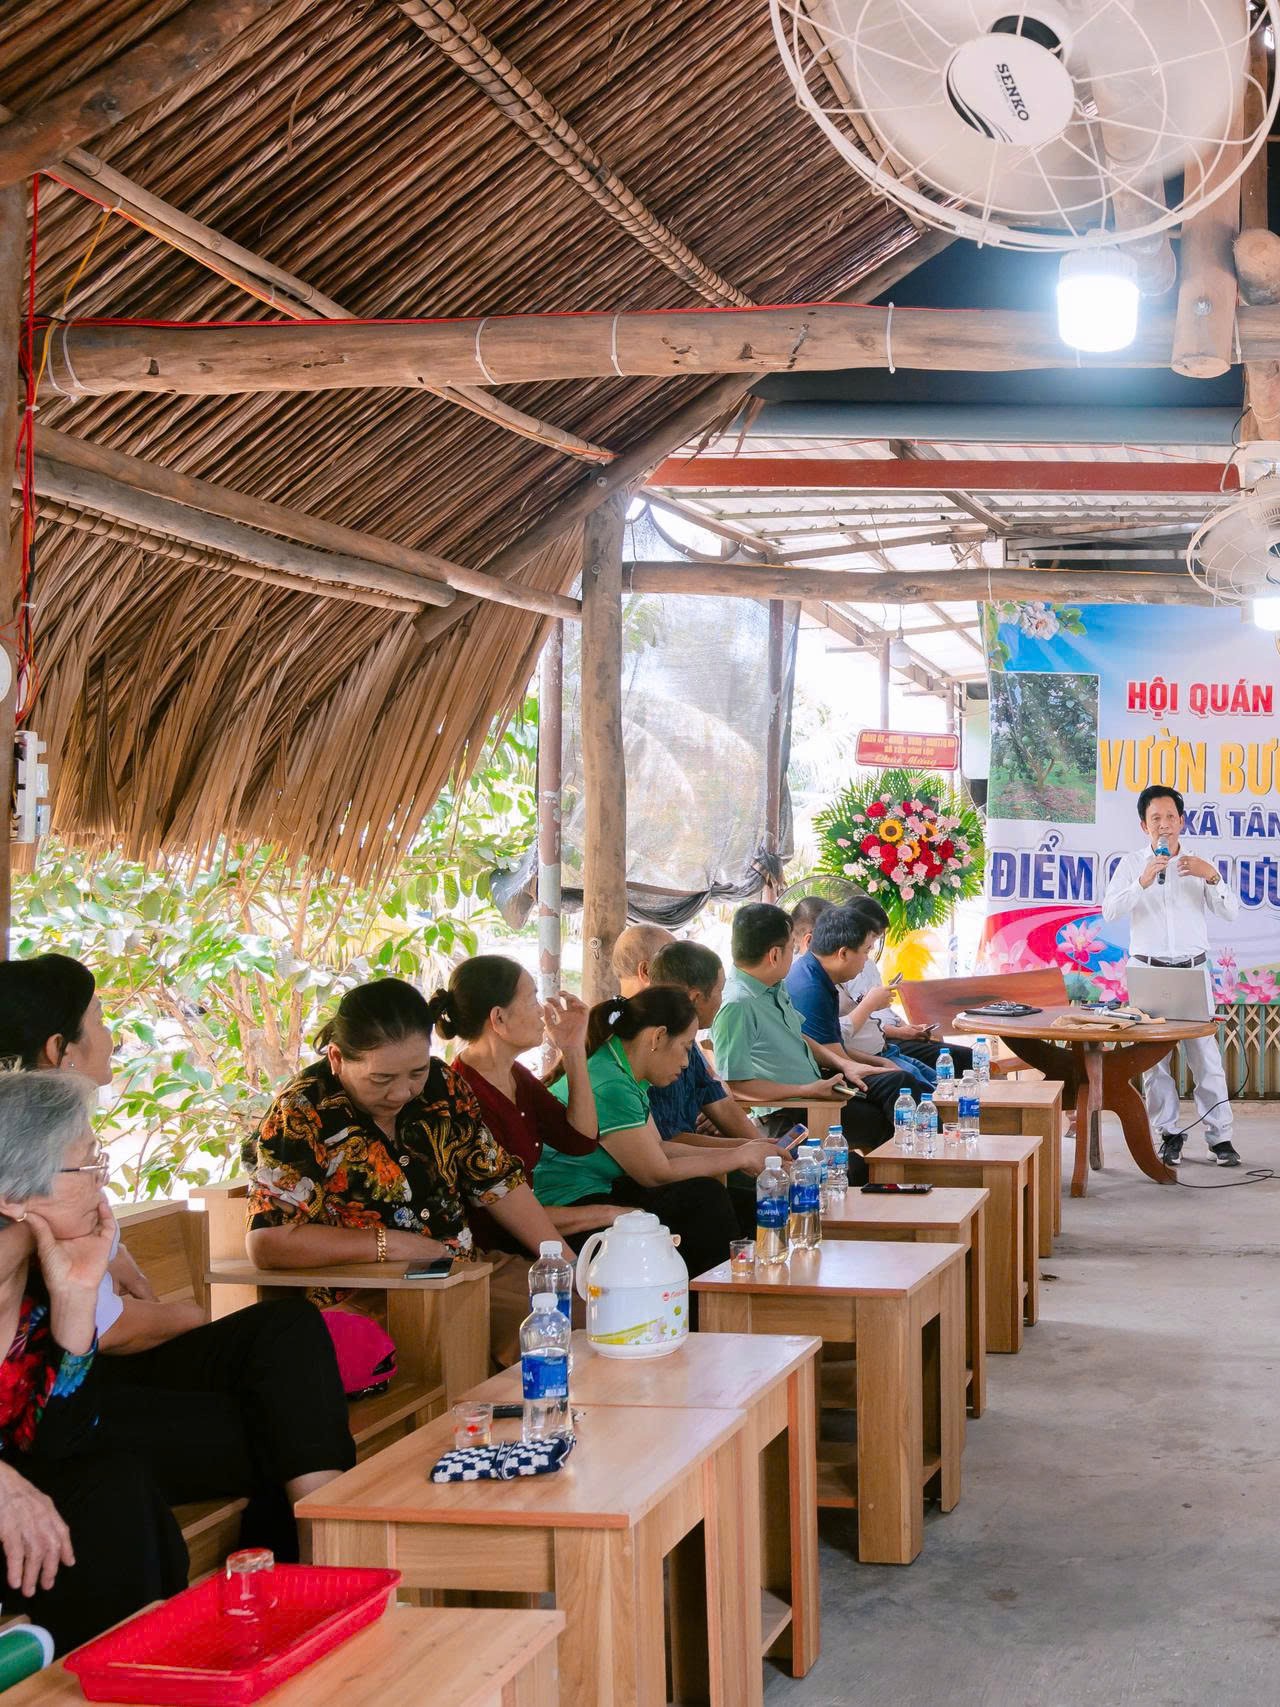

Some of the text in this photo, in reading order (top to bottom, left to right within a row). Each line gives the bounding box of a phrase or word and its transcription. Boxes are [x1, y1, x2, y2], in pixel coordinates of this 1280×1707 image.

[996, 63, 1029, 121] SENKO
[1128, 676, 1178, 717] HỘI
[1190, 679, 1273, 718] QUÁN
[1100, 728, 1207, 794] VƯỜN
[1181, 805, 1219, 836] XÃ
[991, 834, 1094, 901] ĐIỂM
